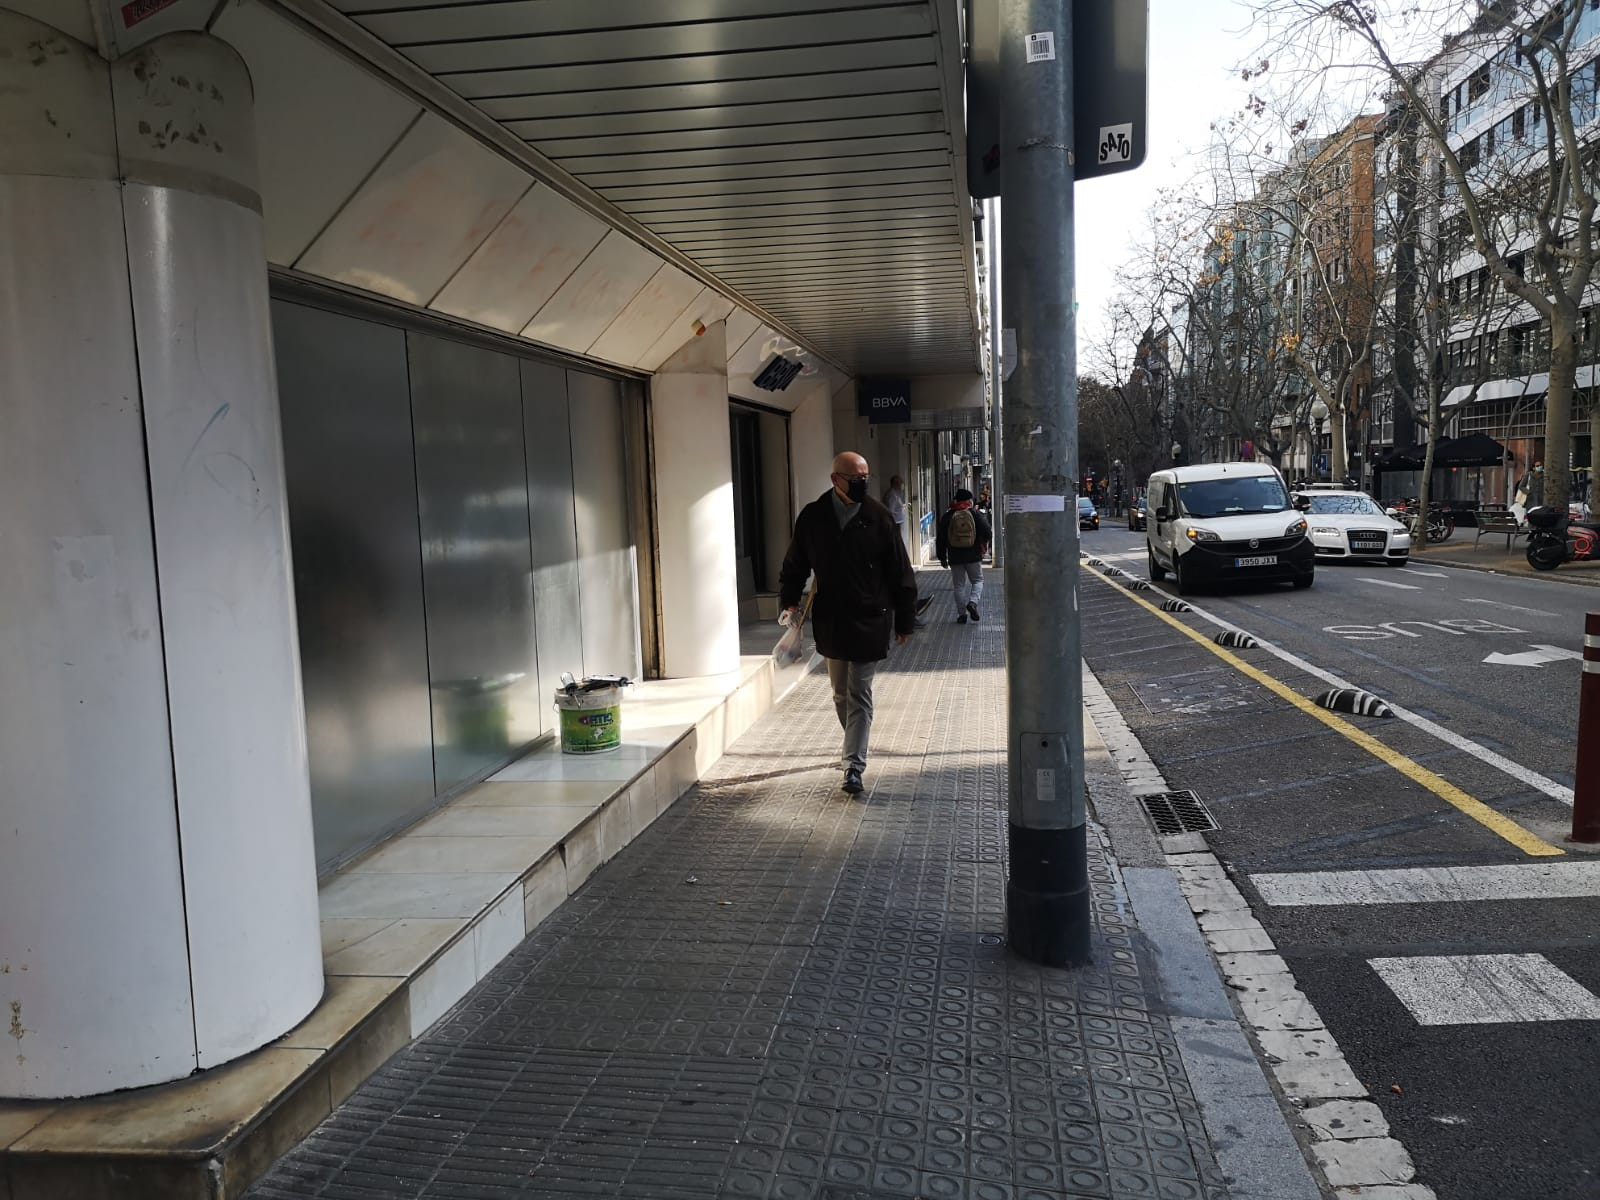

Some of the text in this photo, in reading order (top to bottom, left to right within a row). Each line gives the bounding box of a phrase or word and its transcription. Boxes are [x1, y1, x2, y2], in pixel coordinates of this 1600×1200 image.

[1099, 132, 1130, 162] SATO
[872, 396, 907, 408] BBVA
[1239, 558, 1260, 566] 3950
[1322, 619, 1532, 640] BUS
